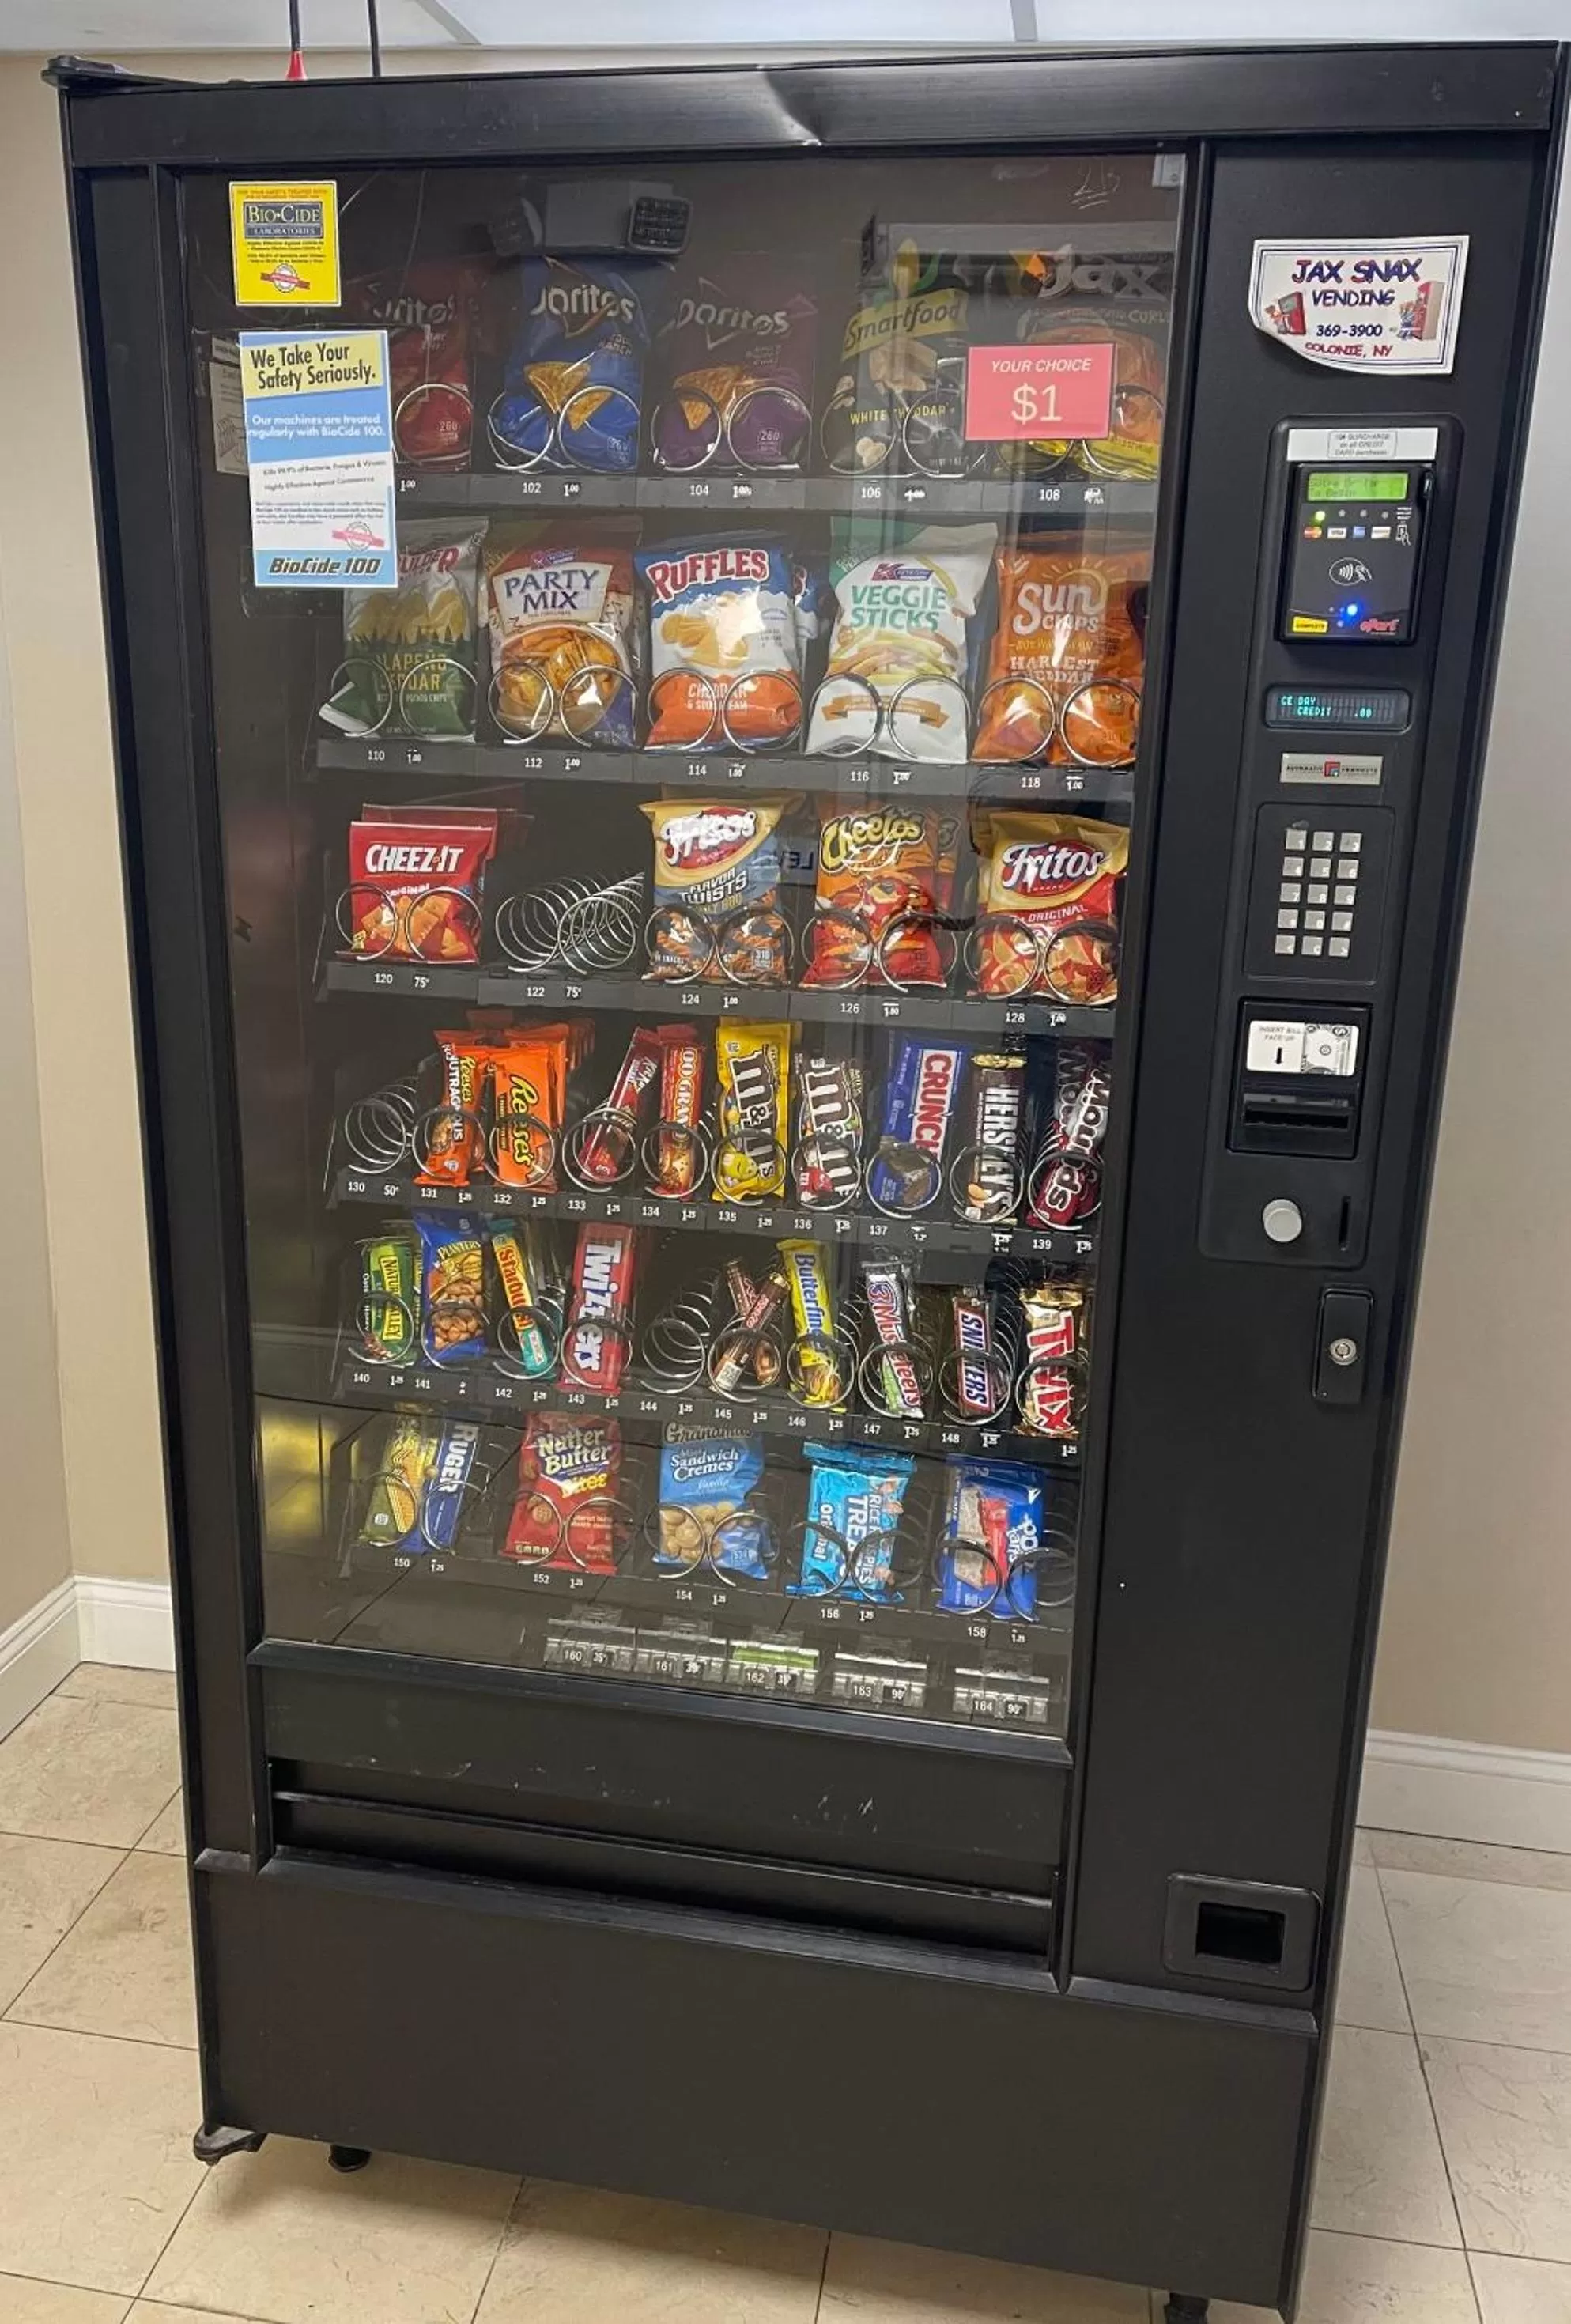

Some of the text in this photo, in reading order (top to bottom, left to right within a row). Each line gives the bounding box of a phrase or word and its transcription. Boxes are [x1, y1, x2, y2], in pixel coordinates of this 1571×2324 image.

[1037, 244, 1166, 301] Jax
[1291, 258, 1423, 283] JAX SNAX
[1312, 289, 1395, 307] VENDING
[676, 298, 789, 336] Doritos
[844, 300, 961, 351] Smartfood
[1316, 324, 1382, 337] 369-3900
[251, 342, 349, 368] We Take Your
[1305, 342, 1393, 357] COLONIE, NY
[991, 358, 1092, 372] YOUR CHOICE
[258, 359, 376, 391] Safety Seriously.
[1011, 383, 1063, 425] $1
[252, 414, 380, 425] Our machines are treated
[850, 409, 887, 425] WHITE
[249, 425, 294, 440] regularly
[297, 425, 319, 436] with
[322, 425, 361, 436] BioCide
[523, 482, 541, 493] 102
[690, 484, 708, 496] 104
[861, 487, 881, 498] 106
[1040, 489, 1060, 501] 108
[270, 557, 341, 574] BioCide
[345, 557, 381, 574] 100
[648, 548, 769, 602] RUFFLES
[504, 569, 600, 598] PARTY
[523, 591, 579, 614] MIX
[852, 585, 946, 609] VEGGIE
[1013, 582, 1105, 636] Sun
[851, 607, 939, 631] STICKS
[1297, 706, 1372, 718] CREDIT .00
[368, 750, 385, 760] 110
[524, 757, 542, 768] 112
[689, 765, 707, 775] 114
[1022, 777, 1040, 788] 118
[823, 812, 923, 869] Cheetos
[1002, 842, 1104, 887] Fritos
[690, 867, 735, 893] FLAVOR
[680, 871, 748, 903] TWISTS
[1028, 904, 1089, 923] ORIGINAL
[375, 973, 393, 984] 120
[527, 987, 545, 997] 122
[682, 994, 700, 1004] 124
[840, 1003, 859, 1014] 126
[1006, 1012, 1025, 1023] 128
[510, 1075, 539, 1166] Reese's
[980, 1086, 1020, 1207] HERSEY'S
[348, 1182, 364, 1192] 130
[421, 1188, 437, 1199] 131
[494, 1194, 512, 1204] 132
[568, 1200, 586, 1211] 133
[642, 1206, 659, 1216] 134
[719, 1211, 737, 1222] 135
[795, 1219, 812, 1229] 136
[870, 1226, 887, 1235] 137
[438, 1241, 481, 1259] PLANTERS
[1033, 1239, 1052, 1249] 139
[382, 1257, 402, 1338] NATUR ALLEY
[795, 1253, 827, 1349] Butterfin
[869, 1284, 921, 1406] 3 Museteers
[1027, 1311, 1075, 1429] TWIX
[353, 1374, 370, 1383] 140
[415, 1379, 431, 1389] 141
[496, 1388, 512, 1398] 142
[568, 1394, 585, 1404] 143
[640, 1401, 657, 1411] 144
[715, 1408, 732, 1419] 145
[863, 1424, 881, 1434] 147
[538, 1428, 605, 1457] Nutter
[942, 1433, 960, 1443] 148
[438, 1423, 474, 1494] RUGER
[544, 1446, 613, 1475] Butter
[670, 1447, 738, 1467] Sandwich
[674, 1461, 734, 1482] Cremes
[534, 1574, 549, 1584] 152
[676, 1590, 692, 1600] 154
[968, 1627, 986, 1638] 158
